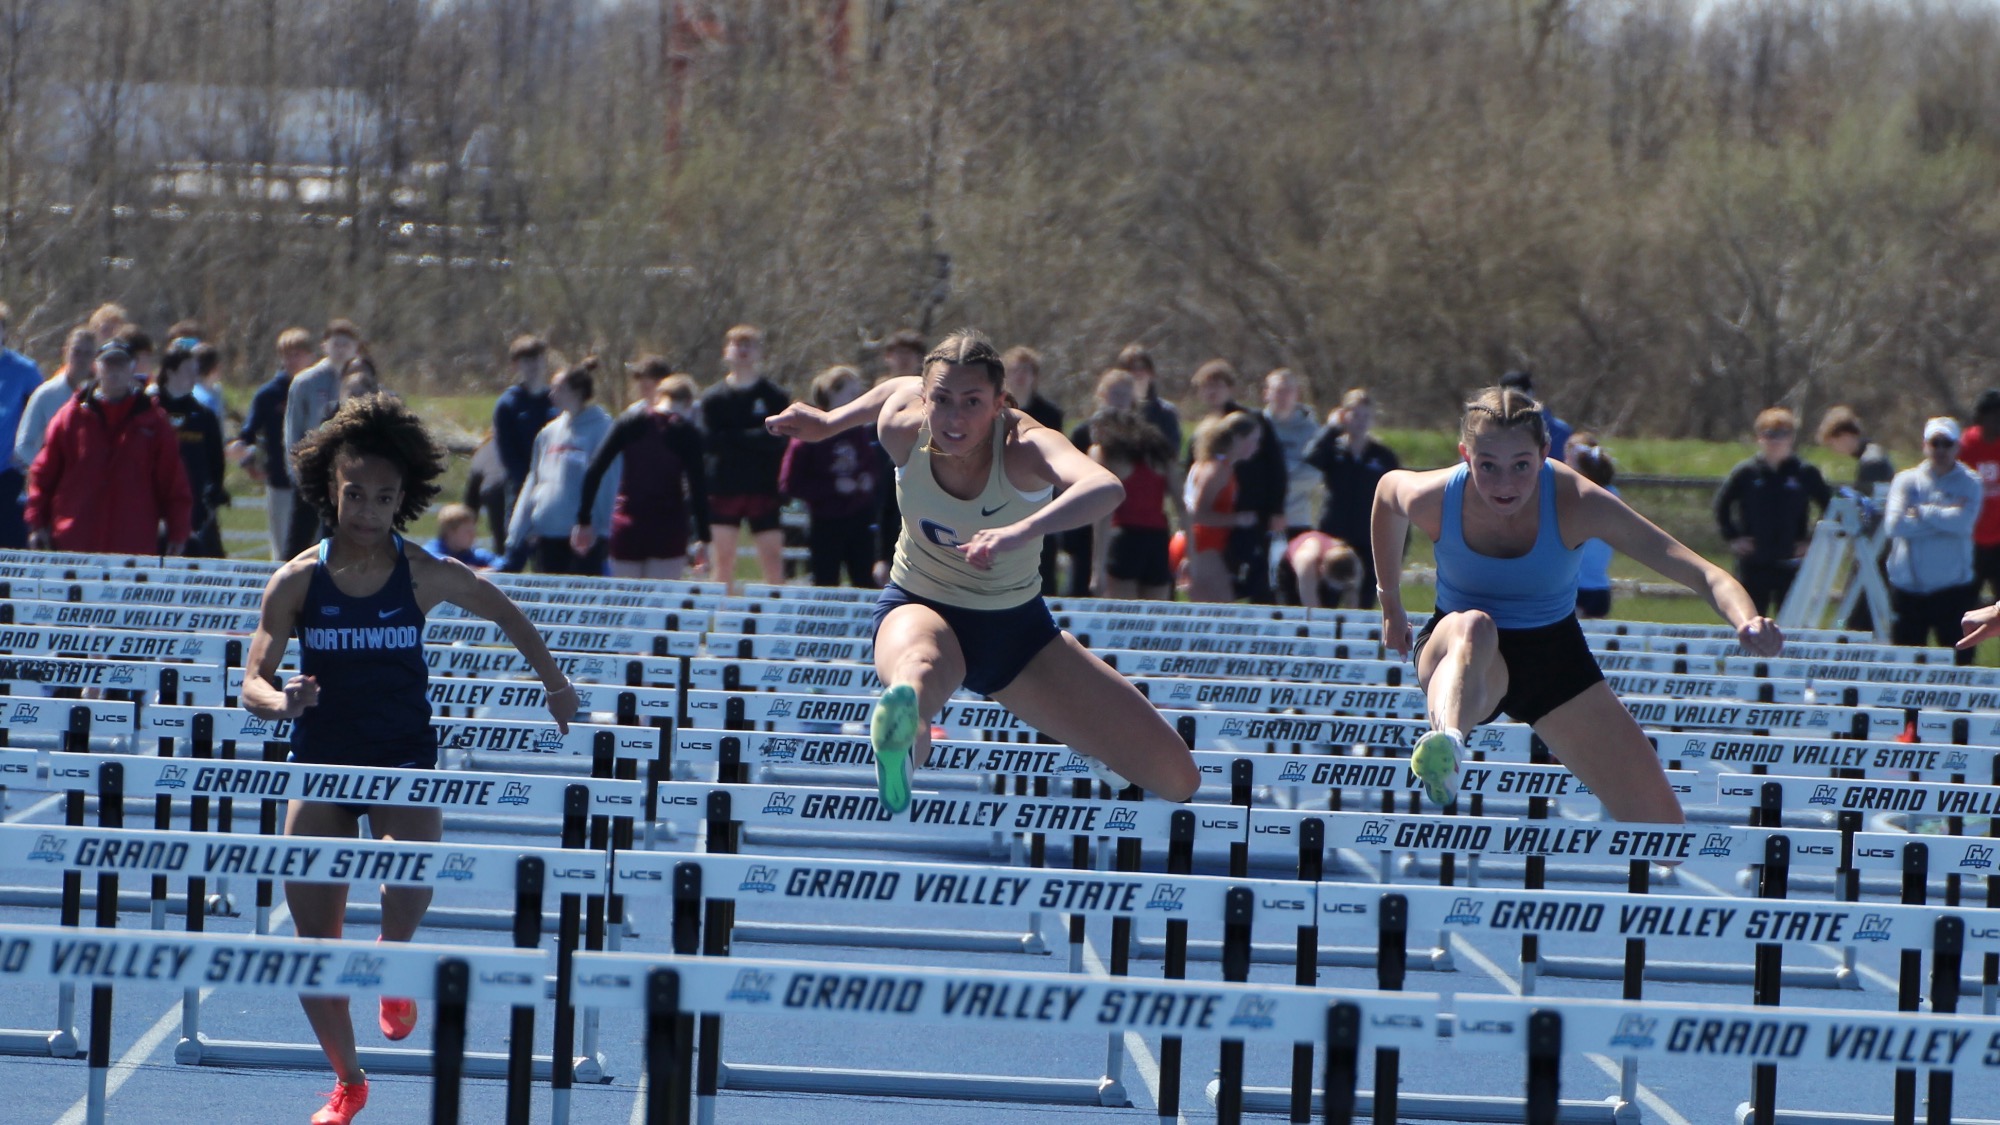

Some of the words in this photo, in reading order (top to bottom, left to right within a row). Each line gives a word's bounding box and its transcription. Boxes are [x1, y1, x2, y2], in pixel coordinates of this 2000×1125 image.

[122, 587, 174, 603] GRAND
[181, 590, 237, 606] VALLEY
[57, 607, 117, 624] GRAND
[123, 609, 184, 627] VALLEY
[188, 613, 241, 630] STATE
[578, 611, 626, 626] STATE
[428, 625, 486, 641] GRAND
[795, 620, 849, 636] GRAND
[48, 632, 115, 653] VALLEY
[120, 636, 178, 656] STATE
[305, 626, 417, 650] NORTHWOOD
[558, 631, 610, 648] STATE
[795, 641, 853, 659] GRAND
[450, 651, 516, 673] VALLEY
[1161, 657, 1217, 674] GRAND
[1291, 661, 1344, 679] STATE
[40, 662, 107, 684] STATE
[183, 675, 211, 683] UCS
[648, 667, 673, 675] UCS
[788, 667, 853, 686] GRAND
[1807, 664, 1859, 680] GRAND
[1867, 667, 1922, 682] VALLEY
[1196, 685, 1262, 704] GRAND
[1341, 691, 1400, 709] STATE
[1663, 681, 1715, 697] STATE
[641, 700, 669, 708] UCS
[691, 700, 718, 709] UCS
[1902, 689, 1962, 707] GRAND
[95, 714, 127, 723] UCS
[797, 700, 870, 722] GRAND
[1674, 706, 1741, 725] VALLEY
[1746, 709, 1804, 727] STATE
[153, 718, 184, 727] UCS
[1873, 719, 1899, 727] UCS
[1921, 722, 1947, 730] UCS
[461, 725, 534, 750] STATE
[1249, 719, 1322, 741] GRAND
[1329, 722, 1405, 745] VALLEY
[621, 740, 652, 749] UCS
[681, 741, 712, 750] UCS
[985, 750, 1060, 774] STATE
[1710, 741, 1784, 763] GRAND
[1792, 745, 1868, 767] VALLEY
[1874, 749, 1940, 770] STATE
[53, 768, 90, 778] UCS
[1311, 763, 1396, 787] GRAND
[1497, 771, 1573, 795] STATE
[193, 767, 291, 795] GRAND
[302, 772, 401, 800] VALLEY
[408, 778, 495, 805] STATE
[1721, 787, 1753, 796] UCS
[596, 794, 632, 804] UCS
[661, 795, 698, 806] UCS
[1842, 786, 1927, 811] GRAND
[909, 798, 1008, 827] VALLEY
[1014, 804, 1102, 831] STATE
[1202, 820, 1238, 829] UCS
[1255, 825, 1291, 835] UCS
[1394, 823, 1492, 850] GRAND
[1503, 827, 1602, 854] VALLEY
[1608, 831, 1696, 857] STATE
[1797, 845, 1833, 855] UCS
[1858, 848, 1895, 858] UCS
[74, 838, 189, 870] GRAND
[203, 843, 321, 876] VALLEY
[329, 849, 433, 881] STATE
[553, 868, 596, 879] UCS
[619, 869, 662, 880] UCS
[784, 867, 900, 901] GRAND
[914, 873, 1031, 906] VALLEY
[1039, 879, 1142, 911] STATE
[1262, 899, 1305, 910] UCS
[1323, 903, 1367, 914] UCS
[1489, 900, 1605, 932] GRAND
[1619, 904, 1737, 937] VALLEY
[1745, 909, 1849, 942] STATE
[50, 940, 194, 980] VALLEY
[205, 947, 331, 987] STATE
[480, 971, 533, 984] UCS
[578, 973, 631, 987] UCS
[782, 972, 924, 1013] GRAND
[942, 980, 1085, 1021] VALLEY
[1097, 989, 1223, 1029] STATE
[1371, 1013, 1423, 1027] UCS
[1460, 1019, 1514, 1033] UCS
[1667, 1016, 1809, 1058] GRAND
[1826, 1022, 1971, 1066] VALLEY
